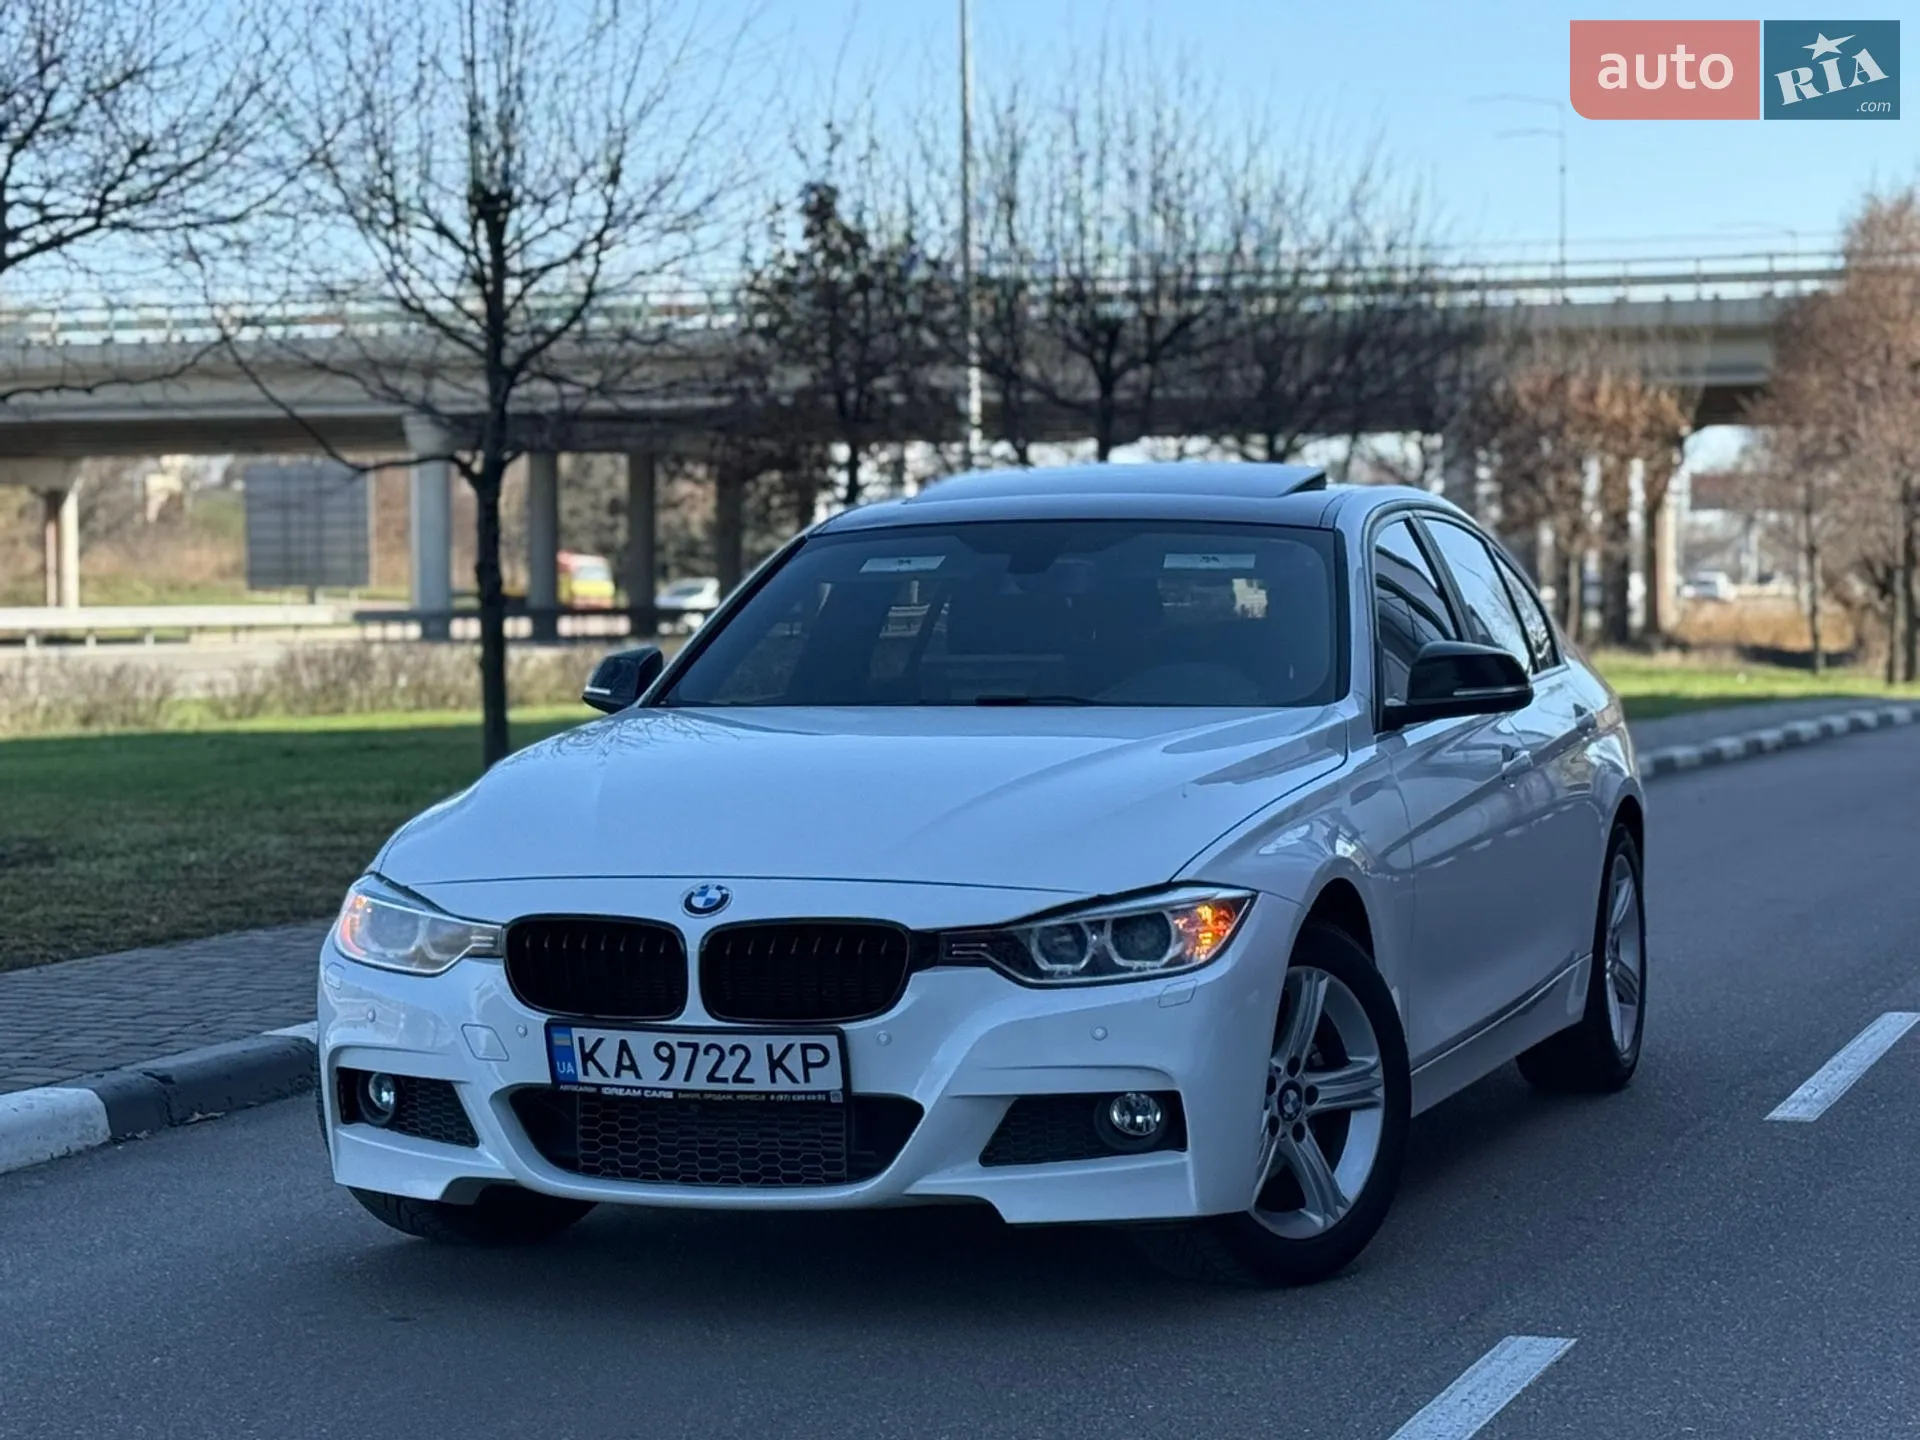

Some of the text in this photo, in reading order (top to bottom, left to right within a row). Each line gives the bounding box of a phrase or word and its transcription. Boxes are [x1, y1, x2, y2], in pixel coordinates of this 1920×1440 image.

[556, 1061, 575, 1075] UA
[578, 1036, 830, 1084] KA 9722 KP
